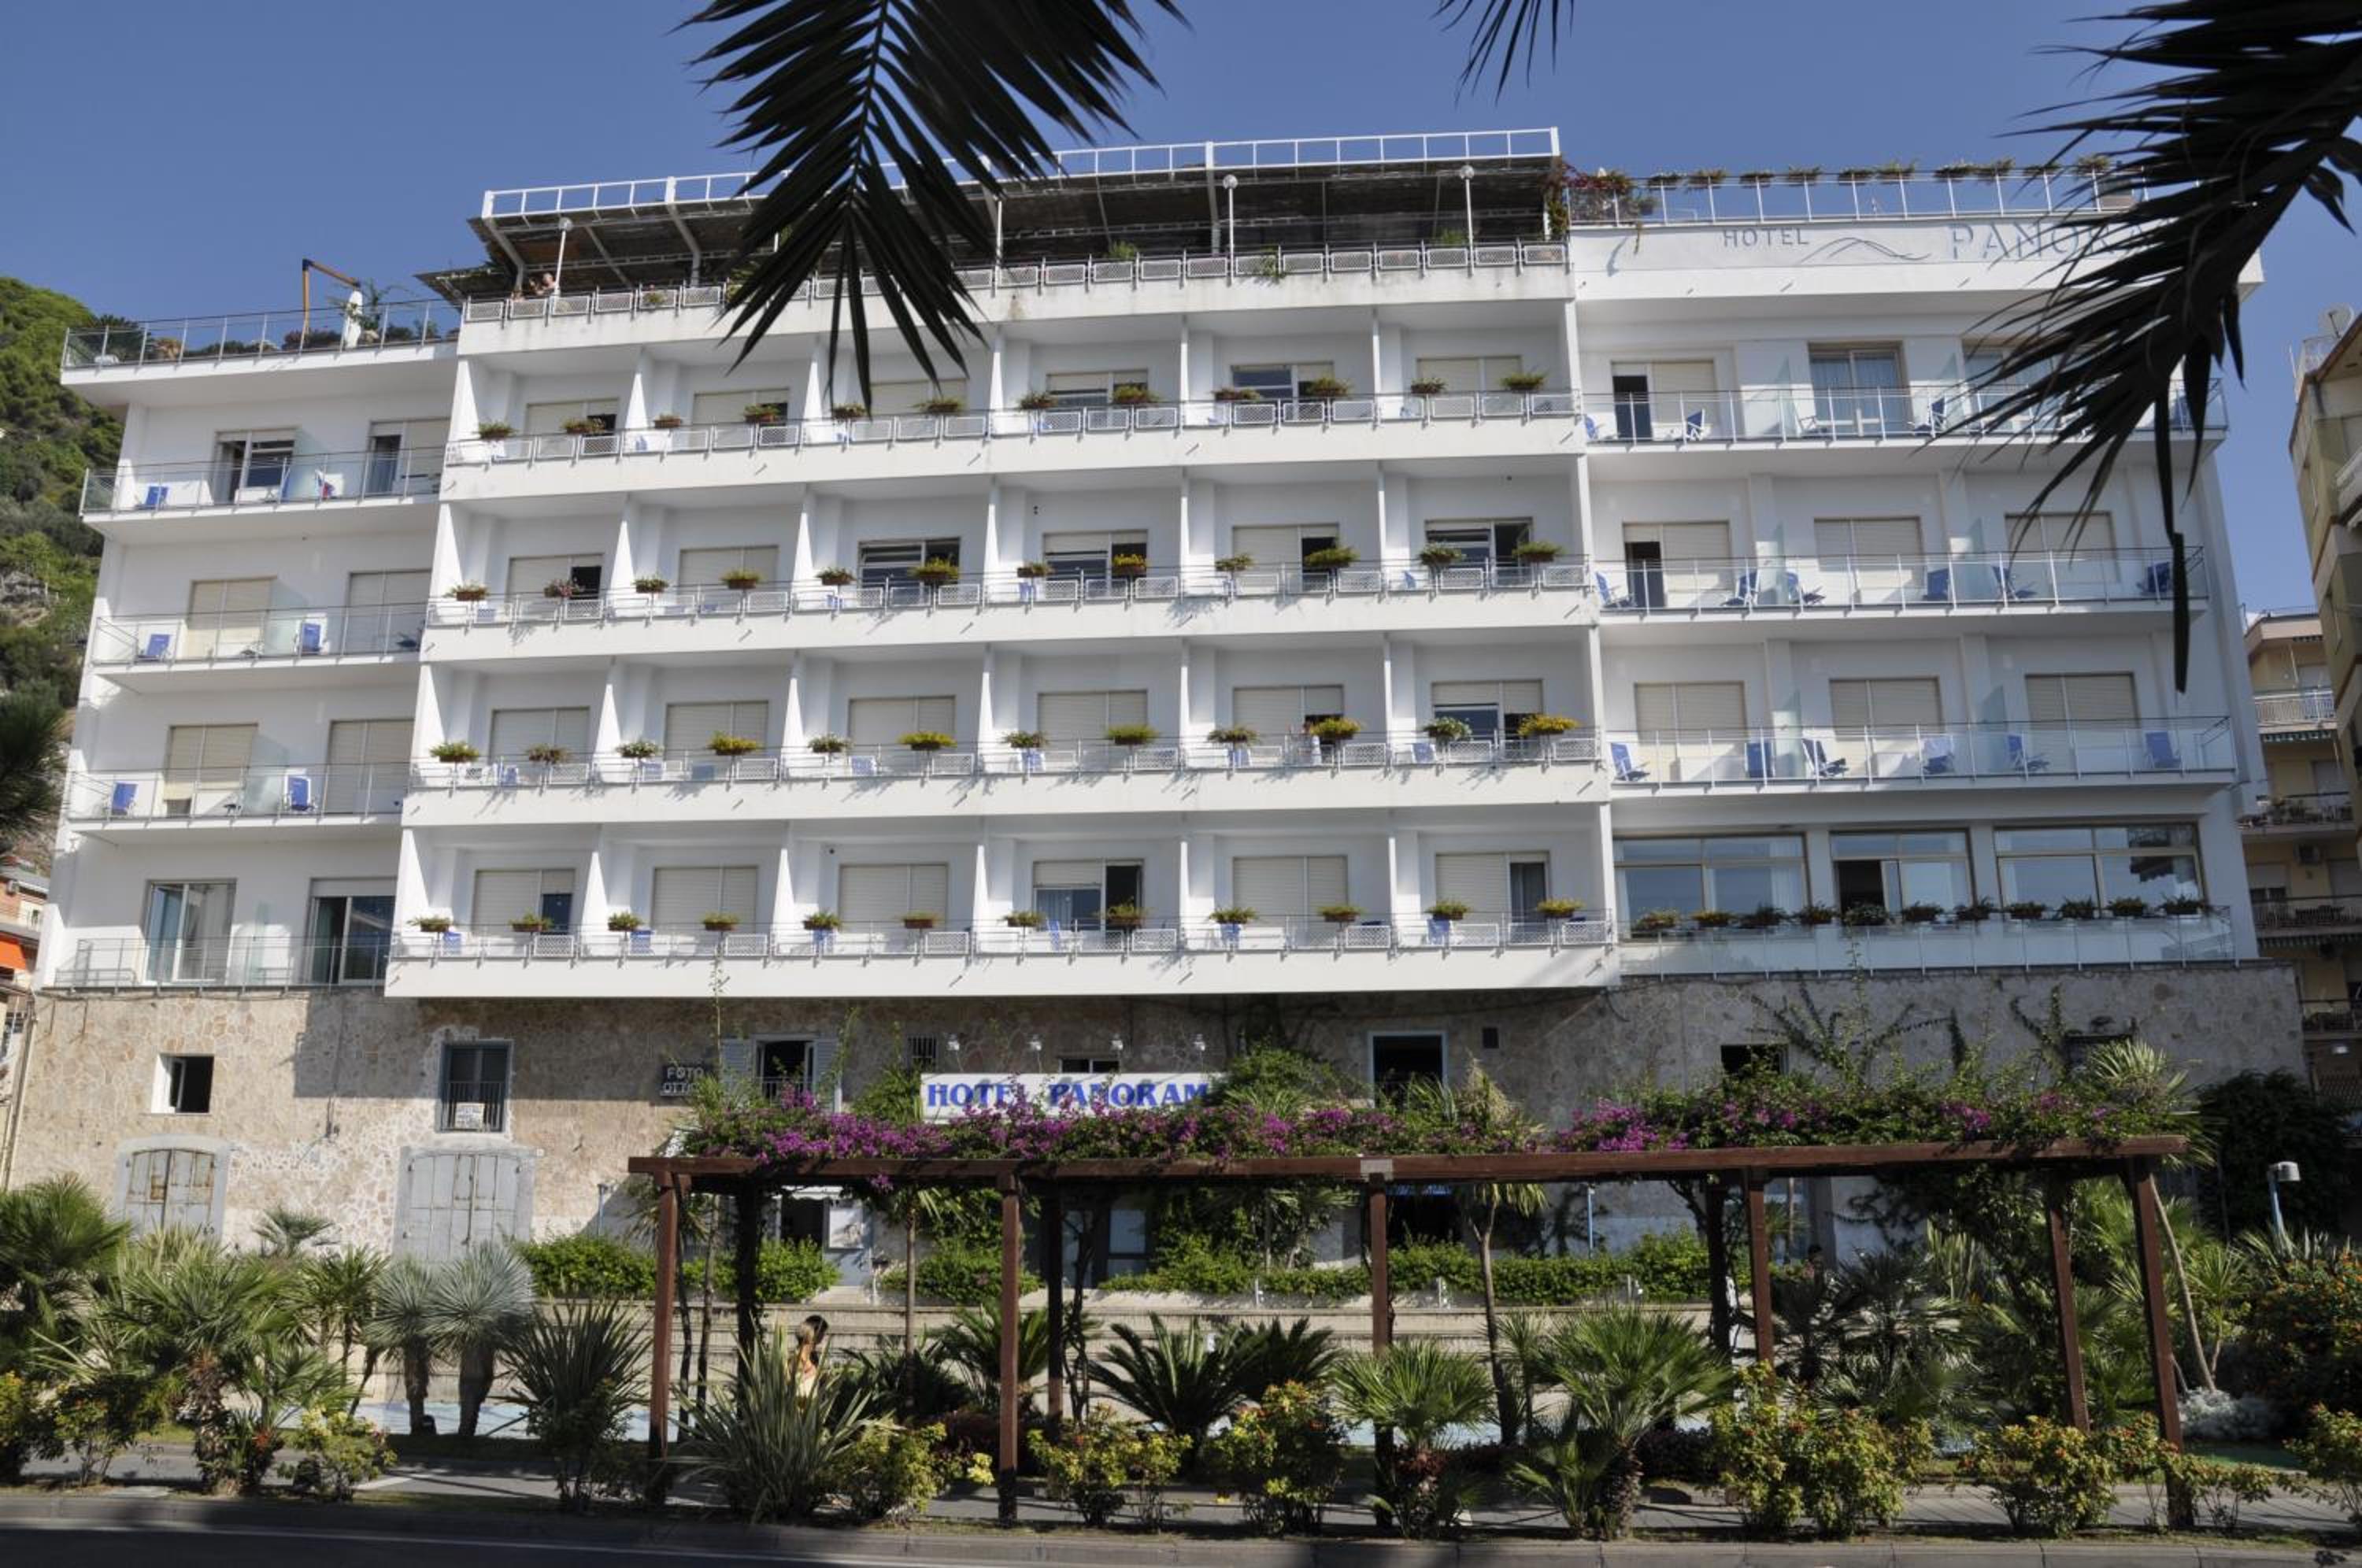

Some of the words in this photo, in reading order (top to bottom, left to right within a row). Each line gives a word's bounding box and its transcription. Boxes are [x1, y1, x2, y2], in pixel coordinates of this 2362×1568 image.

[1723, 227, 1810, 247] HOTEL
[1948, 220, 2143, 260] PANOR
[667, 1066, 705, 1080] FOTO
[927, 1082, 1024, 1108] HOTE
